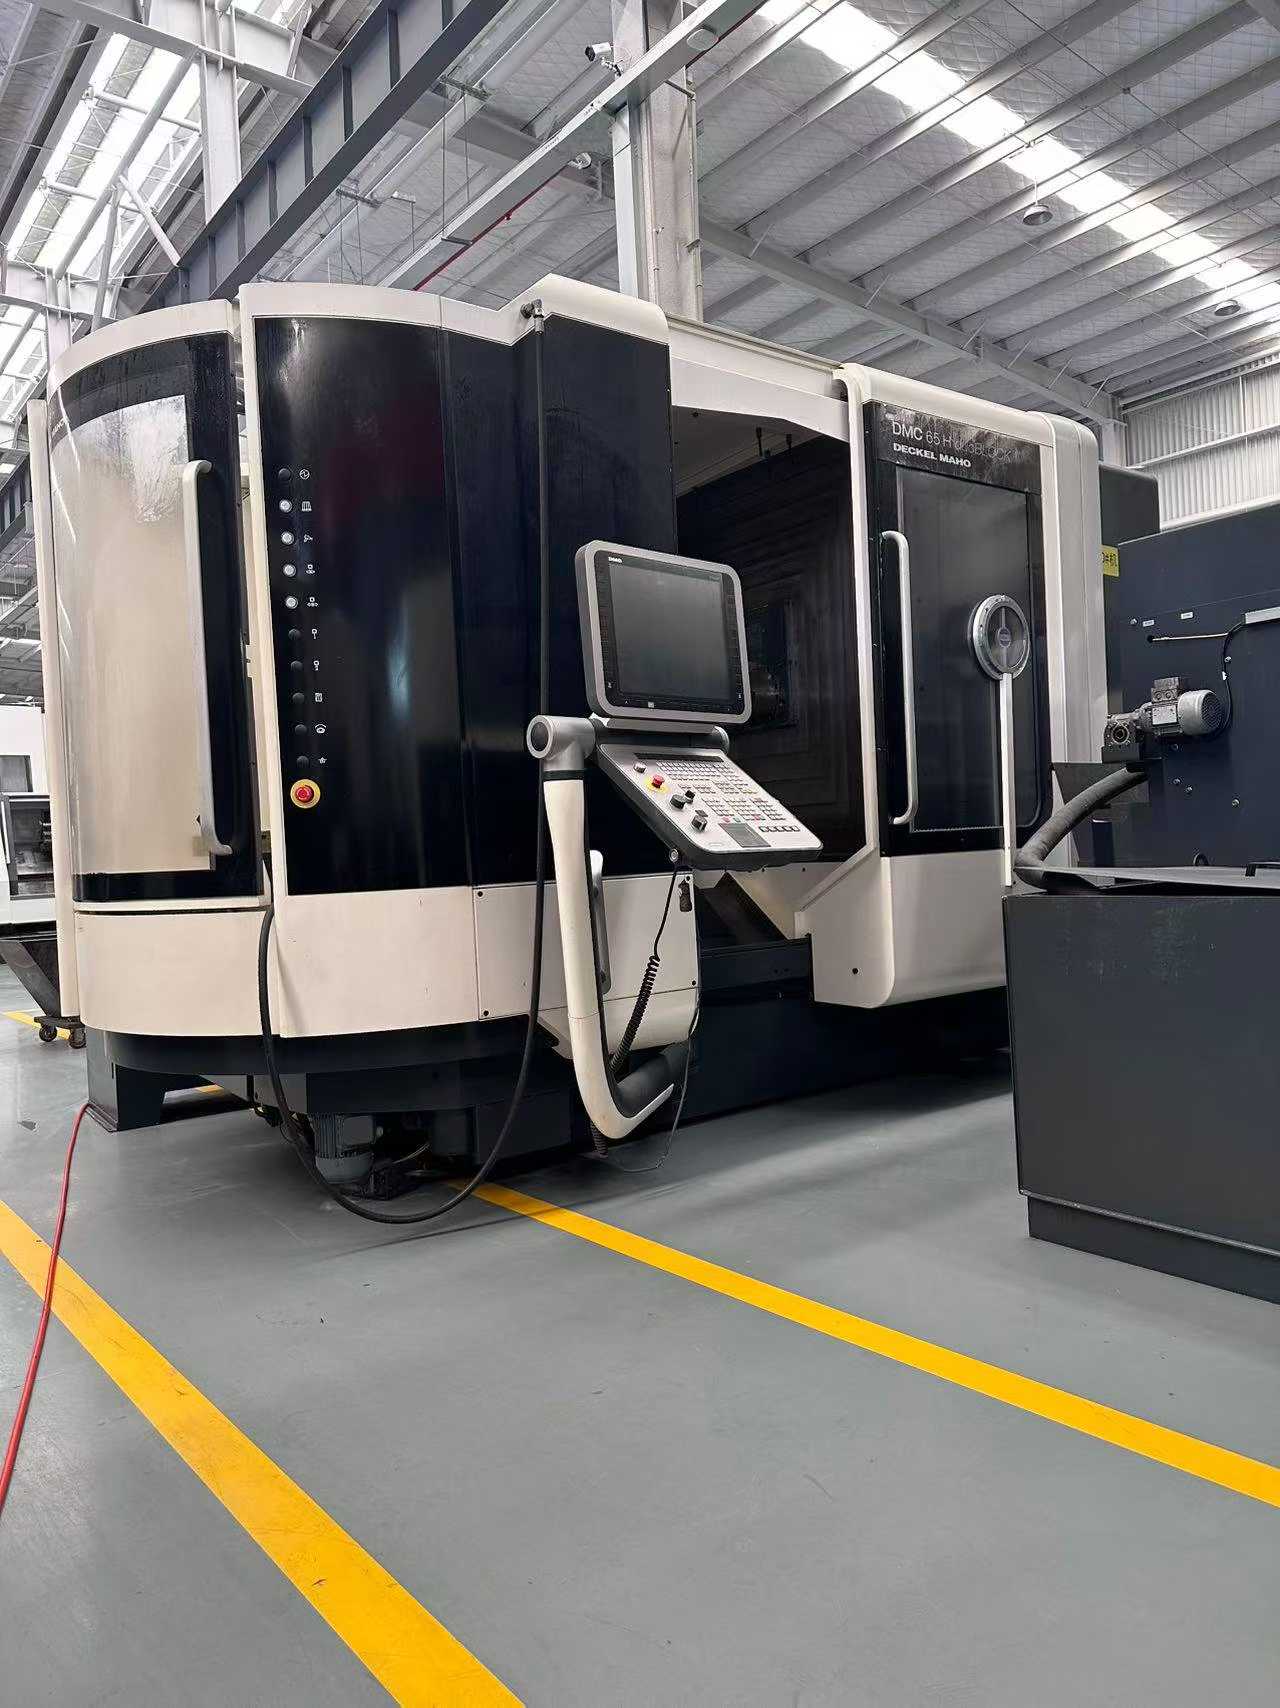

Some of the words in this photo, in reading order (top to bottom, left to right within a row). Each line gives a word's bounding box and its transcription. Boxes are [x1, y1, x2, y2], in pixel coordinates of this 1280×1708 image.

[892, 421, 923, 441] DMC
[926, 430, 941, 445] 65
[893, 442, 938, 460] DECKEL
[939, 453, 972, 468] MAHO
